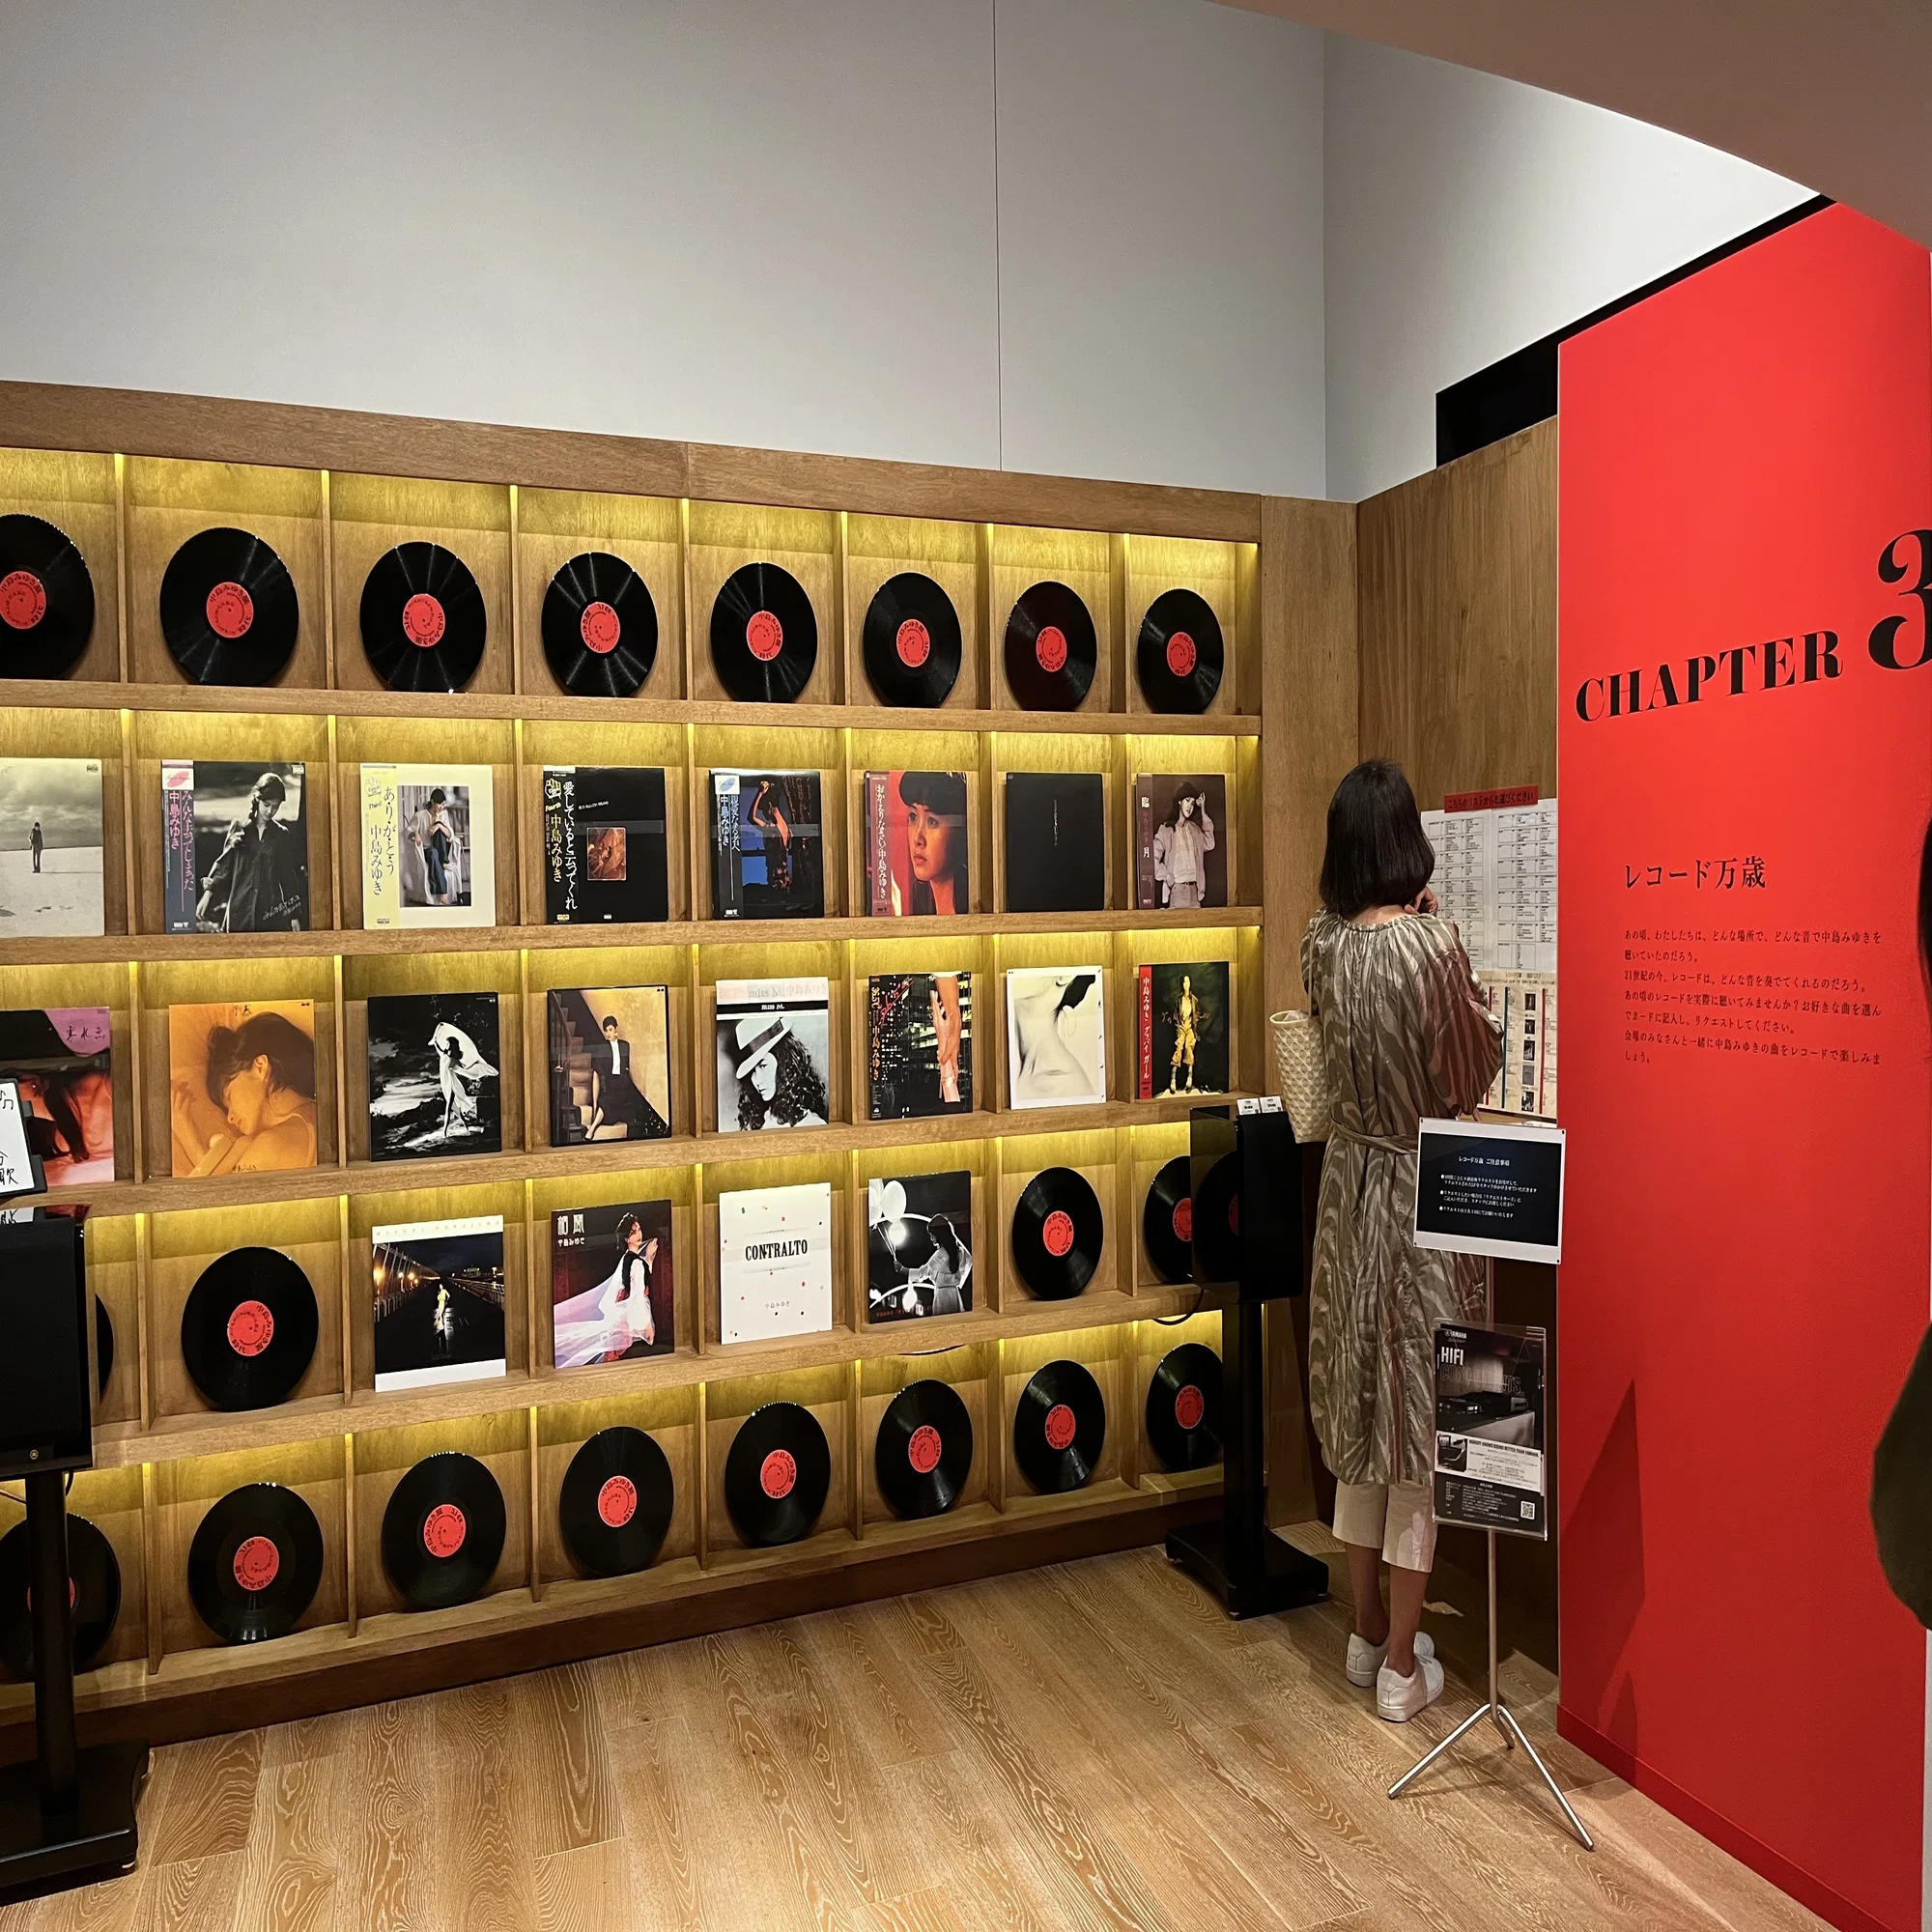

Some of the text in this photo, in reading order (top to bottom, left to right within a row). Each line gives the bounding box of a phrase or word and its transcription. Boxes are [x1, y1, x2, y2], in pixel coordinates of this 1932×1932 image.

[1576, 528, 1932, 722] CHAPTER 3
[370, 825, 383, 895] 中島みゆき
[551, 813, 563, 883] 中島みゆき
[1625, 856, 1767, 890] レコード万歳
[745, 1239, 808, 1261] CONTRALTO
[1450, 1330, 1467, 1340] YAMAHA
[1440, 1346, 1464, 1366] HIFI
